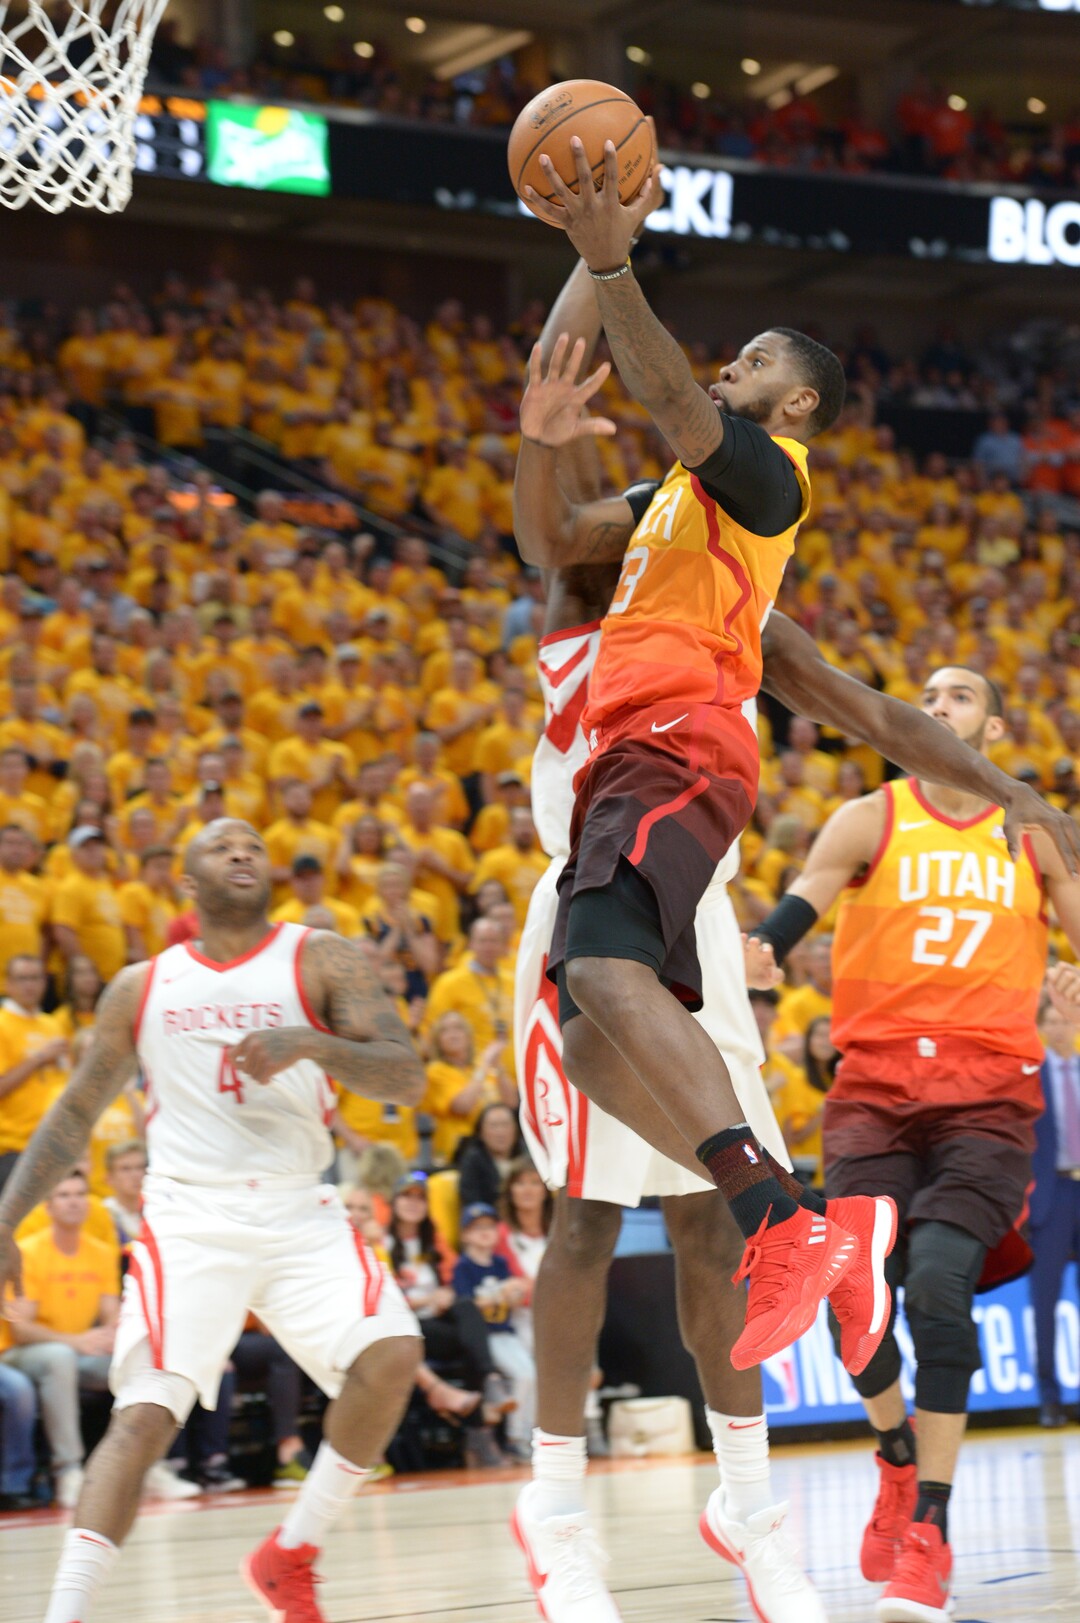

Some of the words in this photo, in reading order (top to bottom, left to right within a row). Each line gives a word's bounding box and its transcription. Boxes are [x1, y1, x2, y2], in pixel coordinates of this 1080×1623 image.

[610, 546, 650, 615] 3
[898, 851, 1016, 908] UTAH
[912, 906, 993, 968] 27
[163, 1002, 284, 1036] ROCKETS
[216, 1045, 246, 1105] 4
